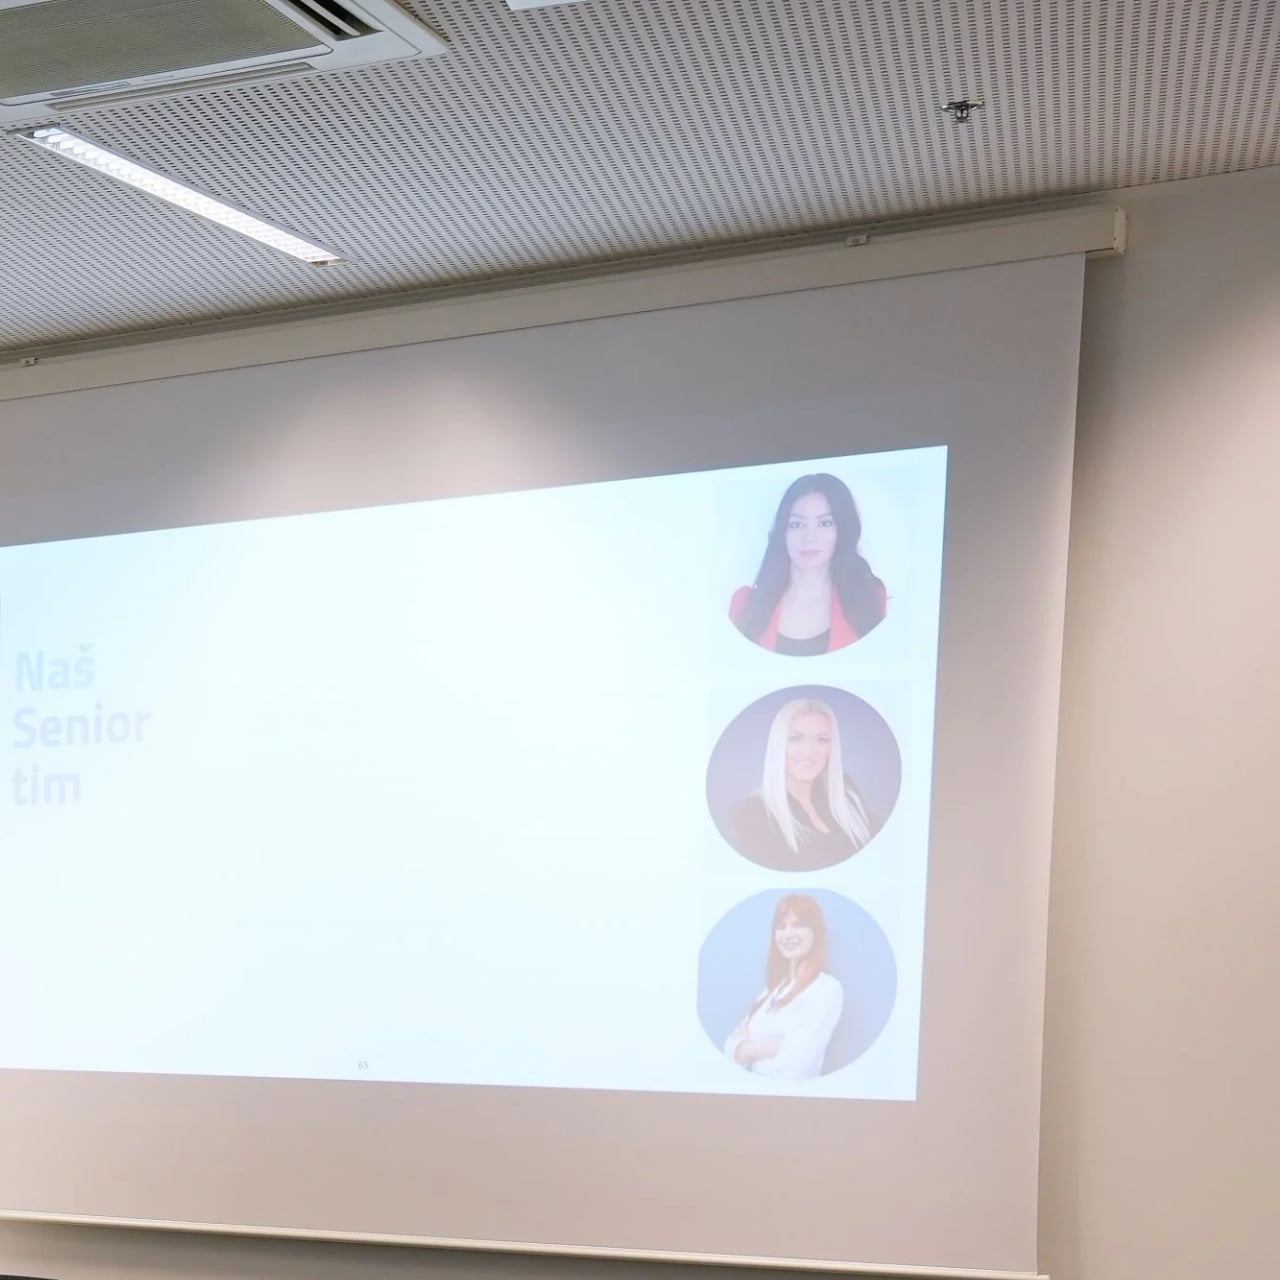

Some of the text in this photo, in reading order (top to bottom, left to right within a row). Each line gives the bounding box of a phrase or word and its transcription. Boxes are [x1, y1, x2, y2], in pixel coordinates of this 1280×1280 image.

[14, 642, 96, 692] Naš
[11, 701, 152, 749] Senior
[11, 763, 82, 807] tim
